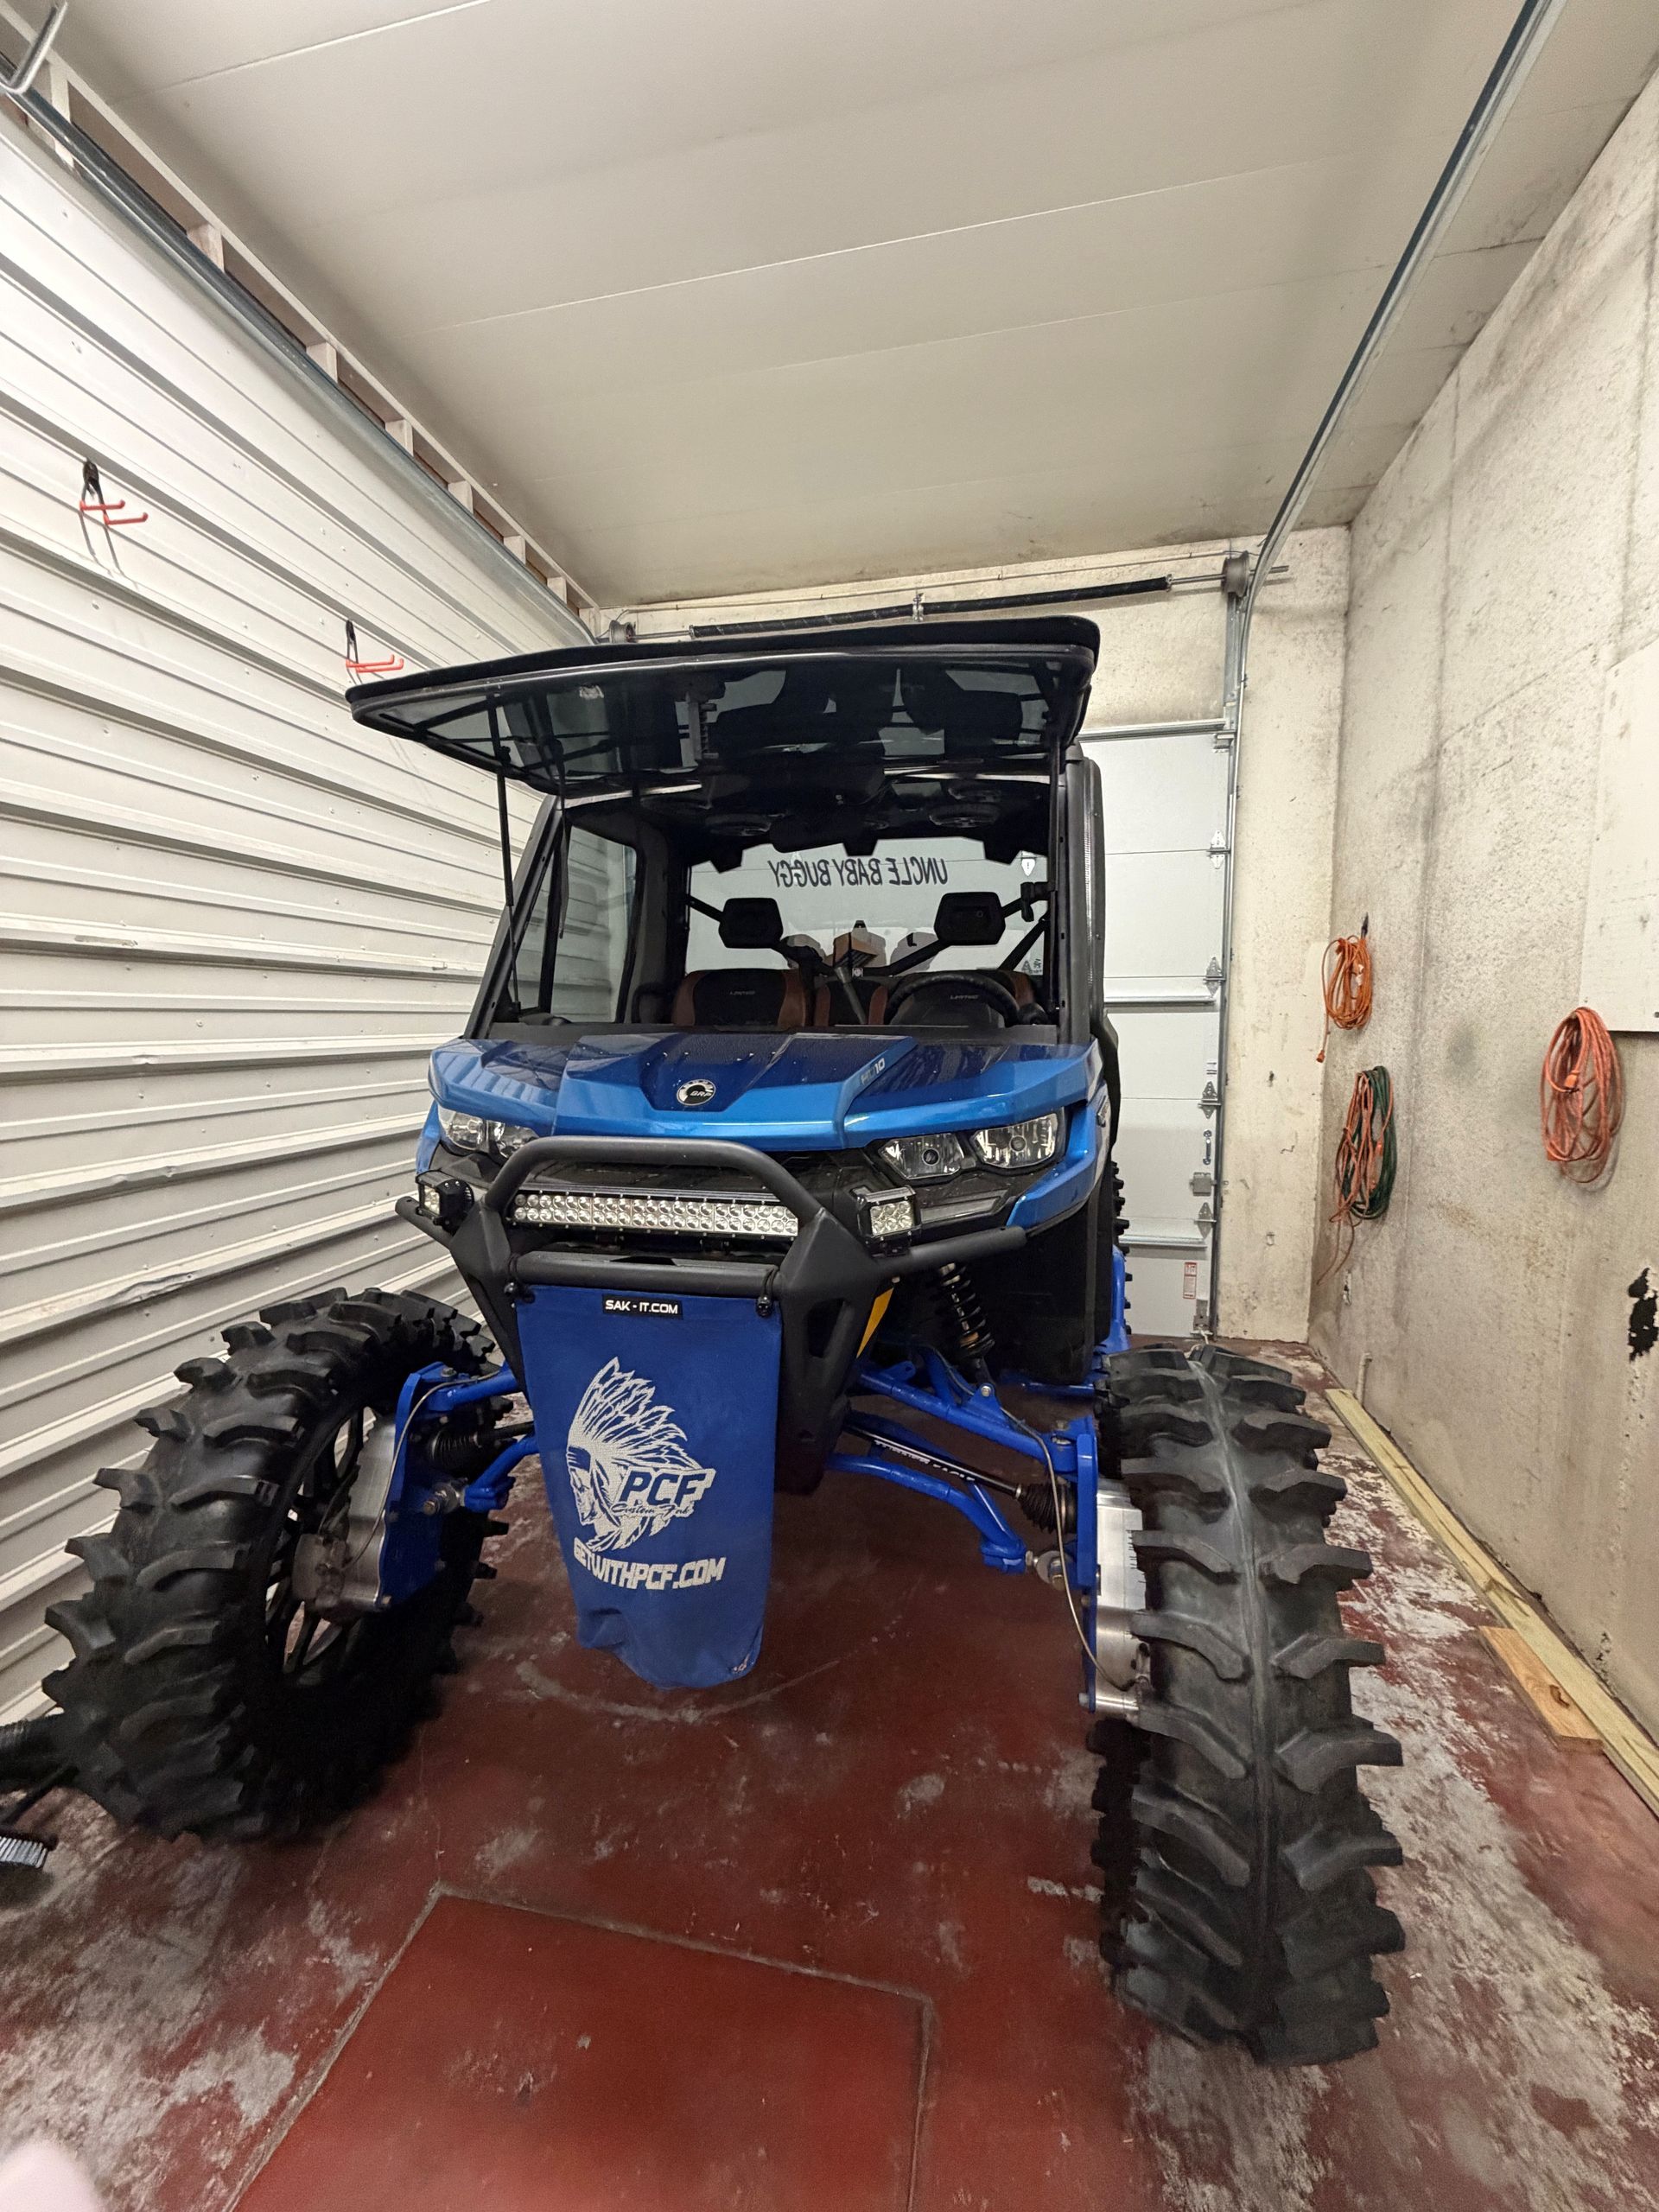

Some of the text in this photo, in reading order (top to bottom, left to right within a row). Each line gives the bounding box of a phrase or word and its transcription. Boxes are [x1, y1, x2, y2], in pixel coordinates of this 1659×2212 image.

[605, 1299, 632, 1312] SAK
[639, 1301, 679, 1314] IT.COM
[618, 1470, 708, 1508] PCF
[610, 1503, 656, 1515] Custom
[573, 1536, 728, 1591] GETWITHPCF.COM
